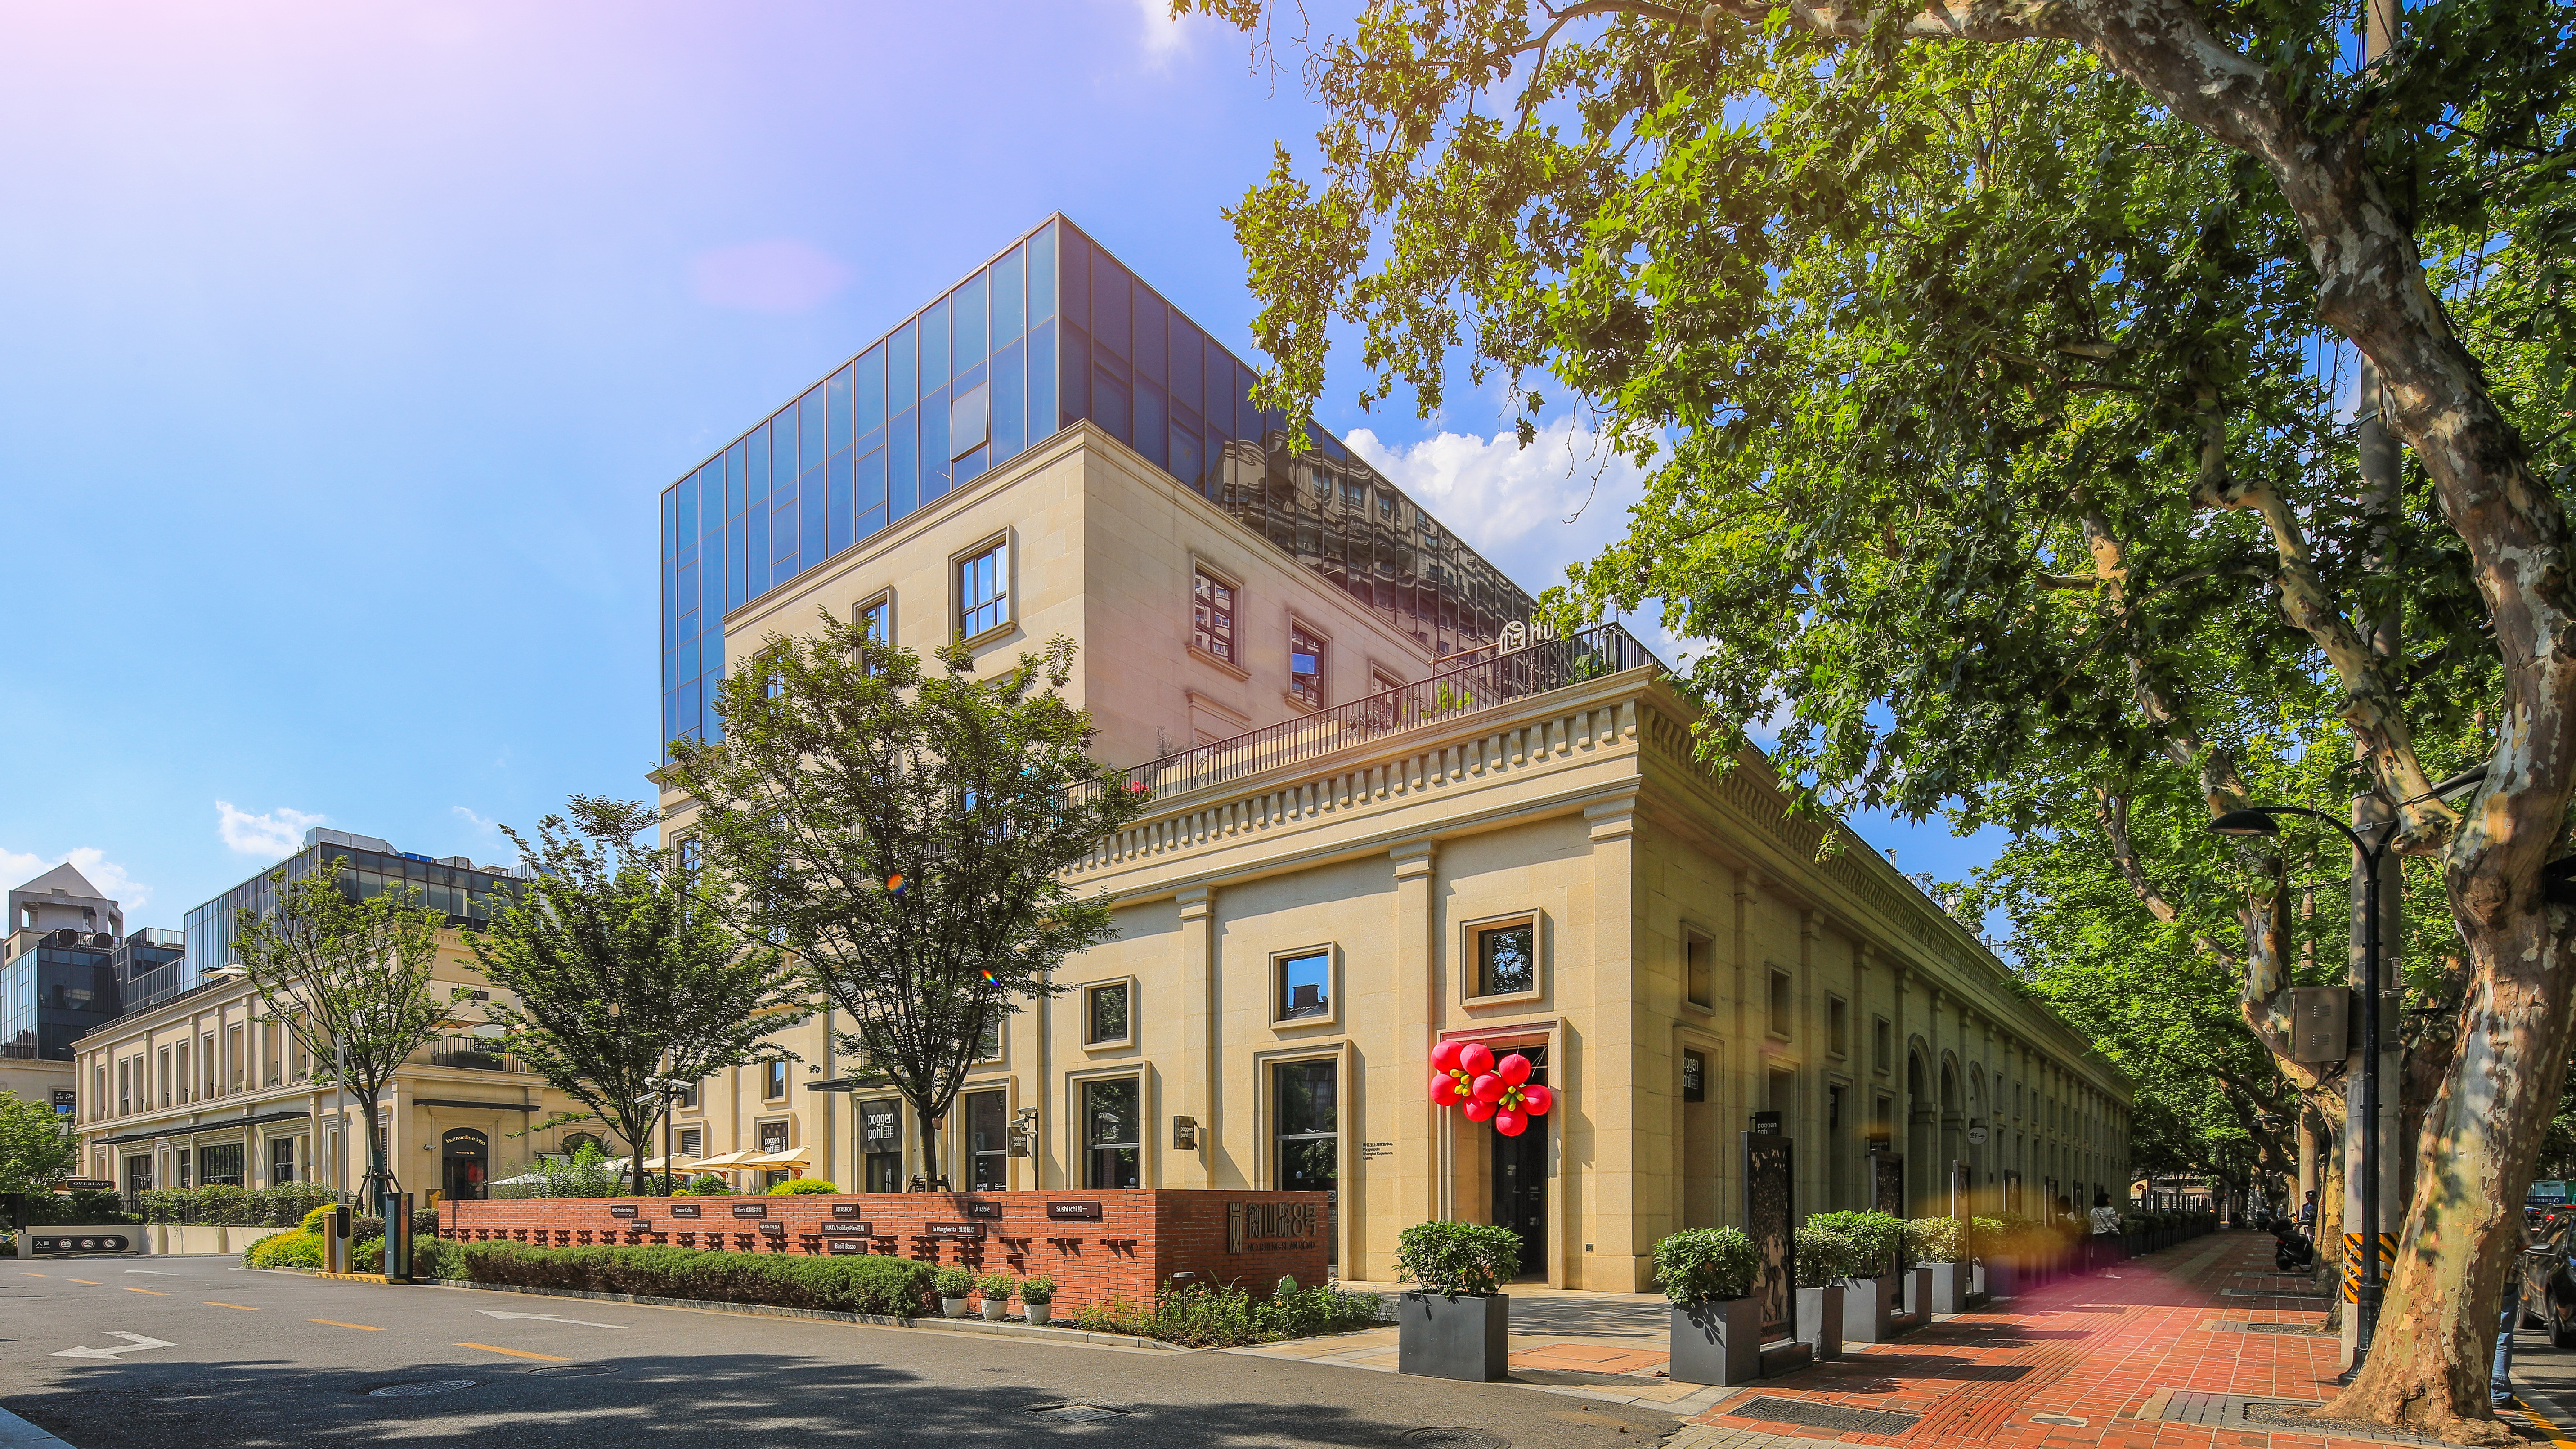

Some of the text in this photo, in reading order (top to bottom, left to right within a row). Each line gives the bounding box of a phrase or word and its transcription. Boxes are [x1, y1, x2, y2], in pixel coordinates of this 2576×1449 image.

[1683, 1057, 1698, 1072] oggen
[868, 1113, 893, 1127] poggen
[445, 1135, 471, 1144] Mozzarella
[476, 1137, 485, 1145] Vino
[868, 1126, 883, 1141] pohl
[765, 1137, 780, 1146] poggen
[765, 1145, 774, 1153] pohl
[1248, 1203, 1317, 1239] 衡山路8号
